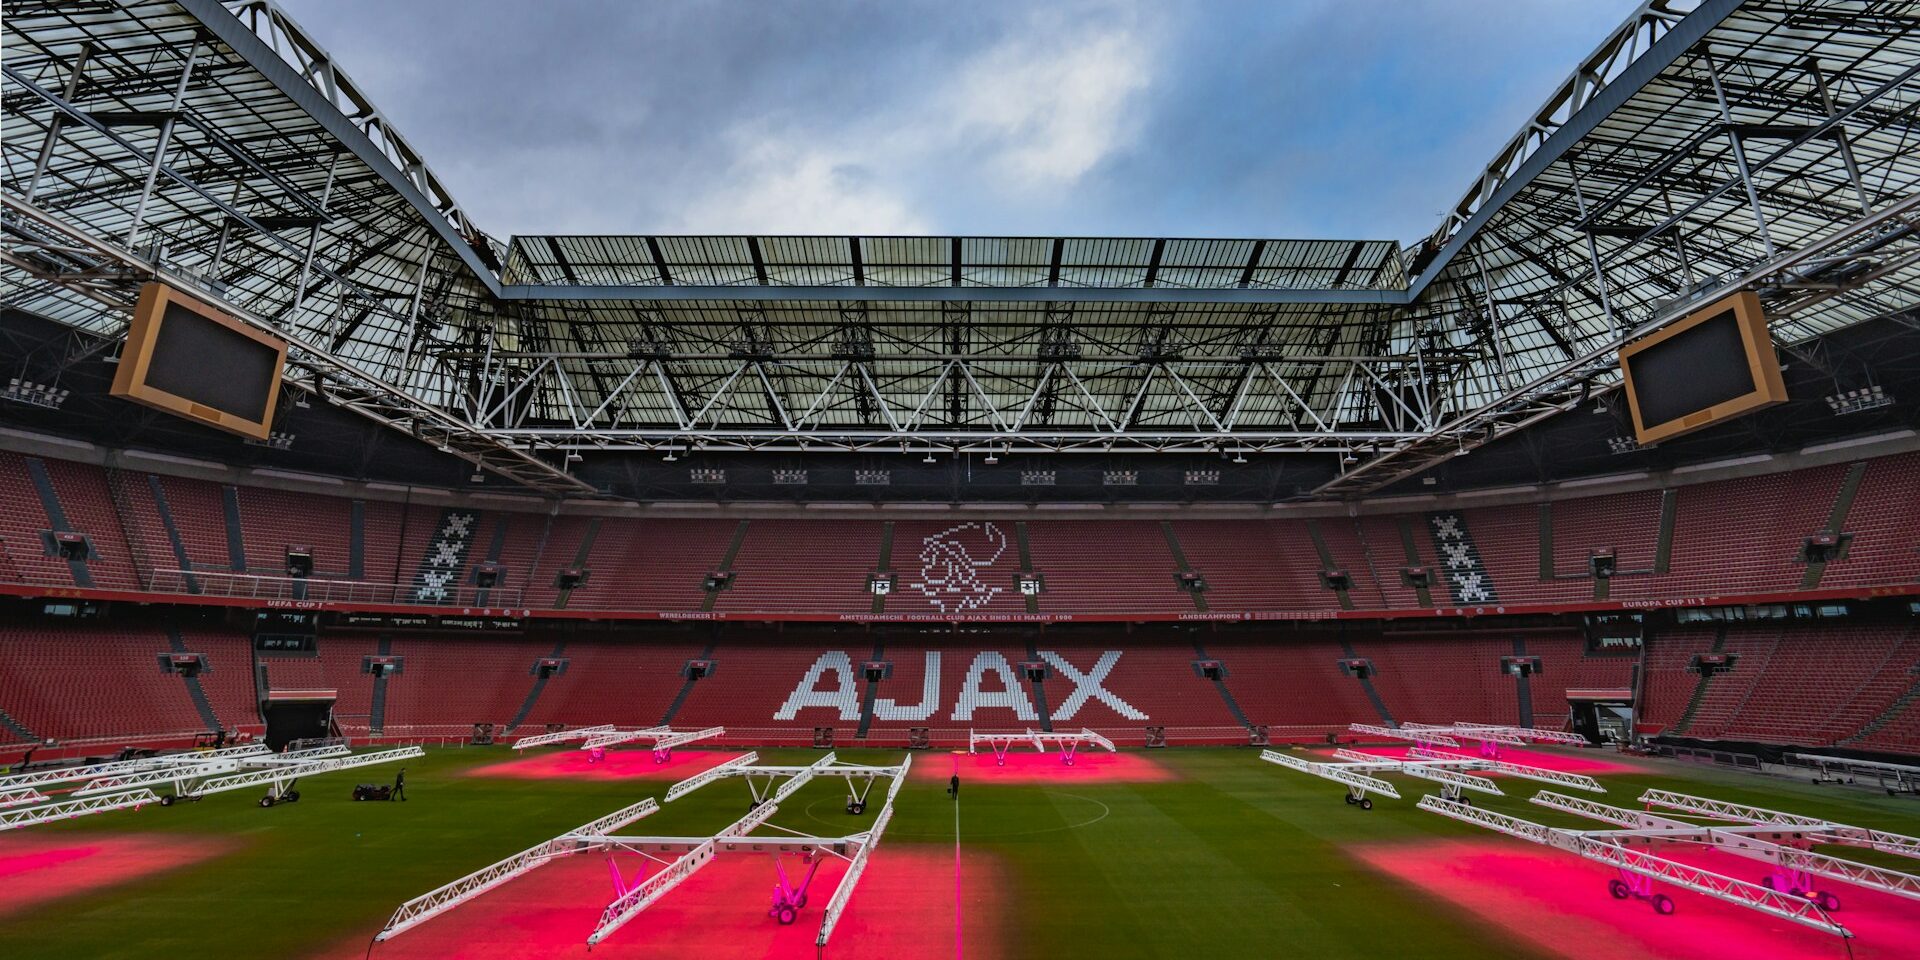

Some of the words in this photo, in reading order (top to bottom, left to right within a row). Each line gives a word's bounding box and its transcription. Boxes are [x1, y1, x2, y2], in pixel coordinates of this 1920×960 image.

[296, 601, 315, 609] CUP
[1622, 600, 1662, 608] EUROPA
[967, 614, 987, 622] AJAX
[773, 651, 1149, 720] AJAX
